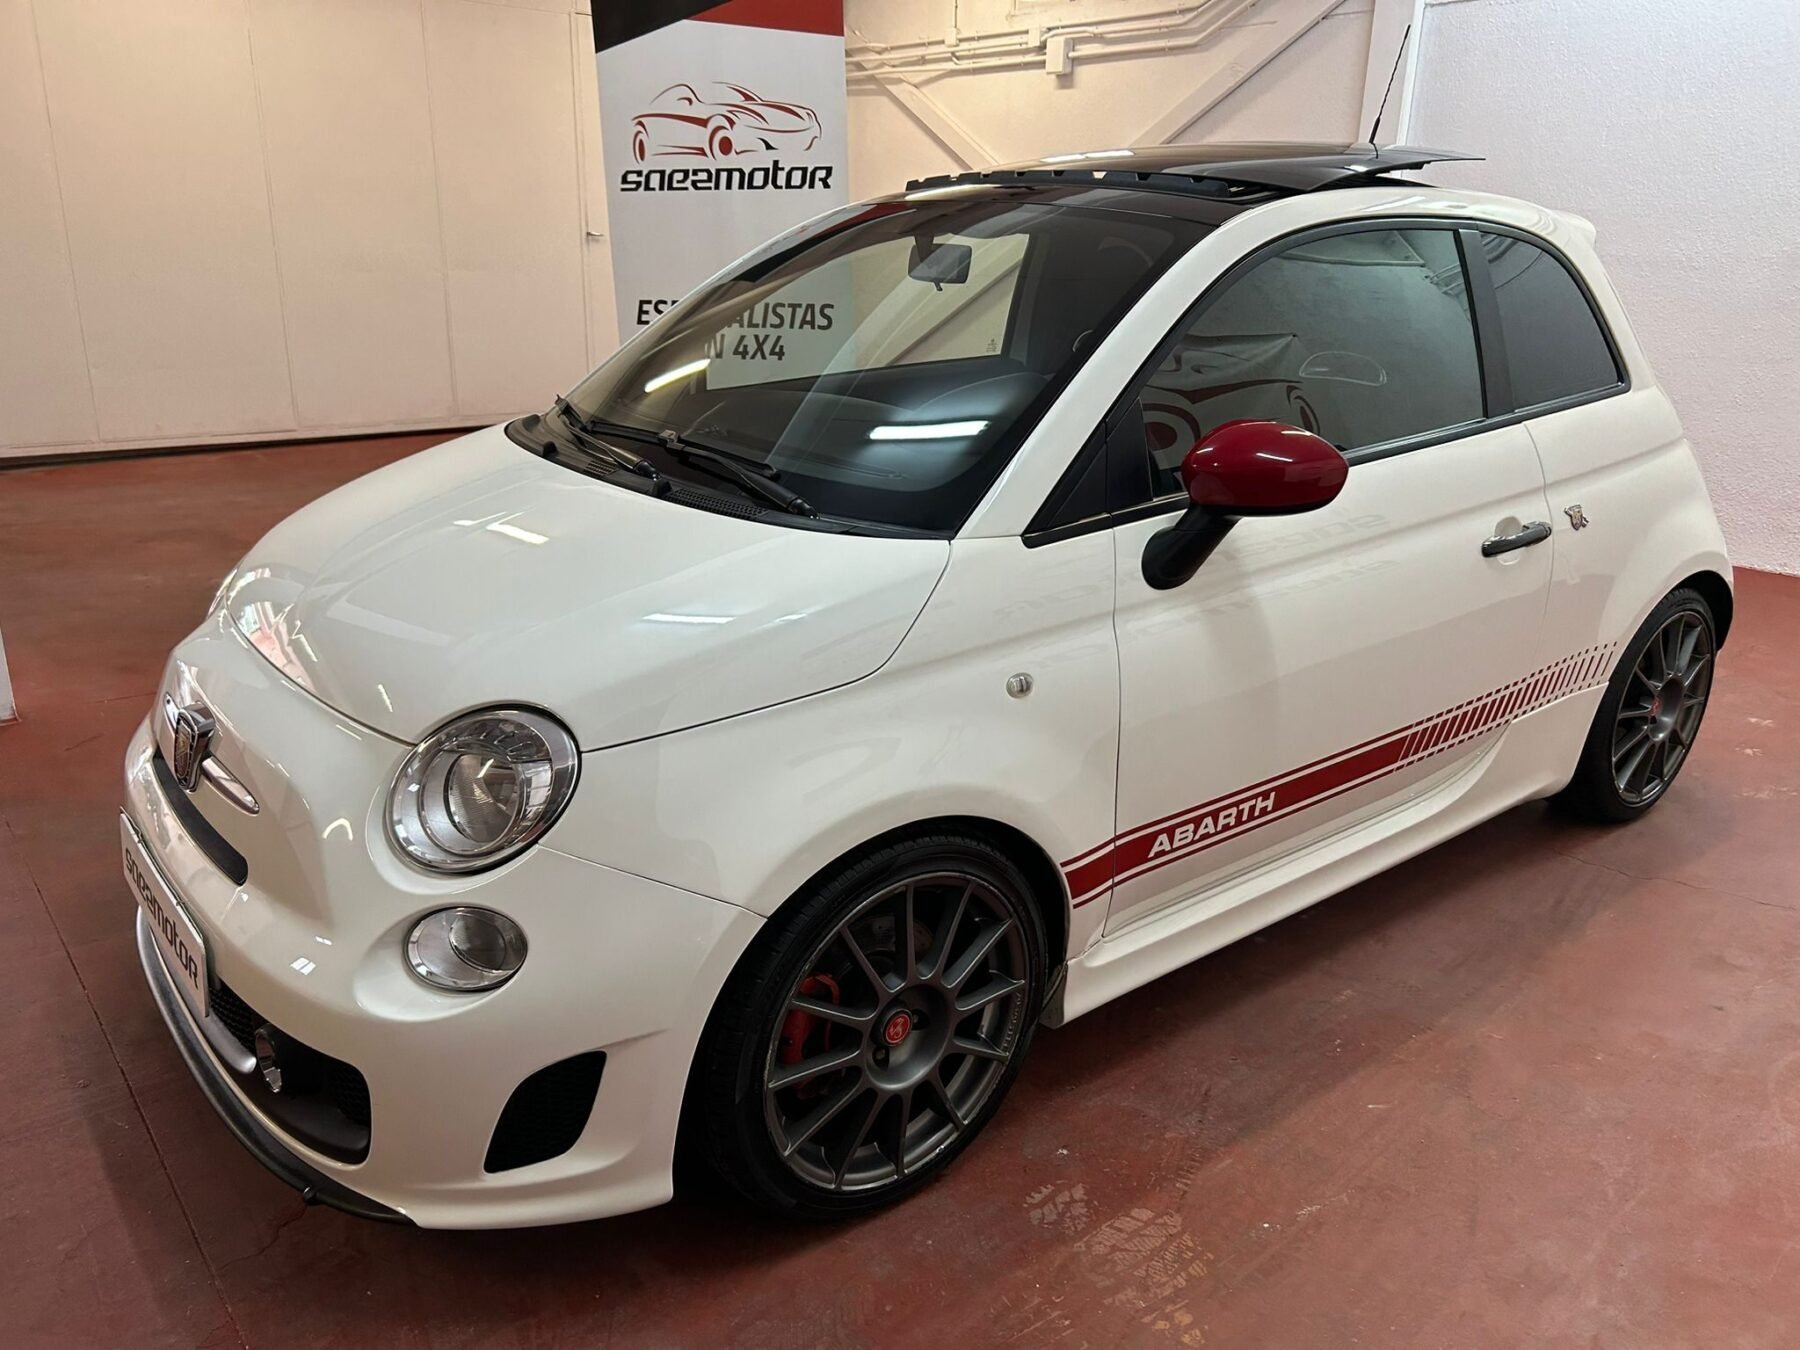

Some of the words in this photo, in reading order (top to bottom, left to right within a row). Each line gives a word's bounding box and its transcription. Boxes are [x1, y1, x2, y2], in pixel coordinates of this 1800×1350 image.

[636, 300, 834, 331] ESALISTAS
[733, 334, 785, 361] 4X4
[1148, 792, 1276, 858] ABARTH
